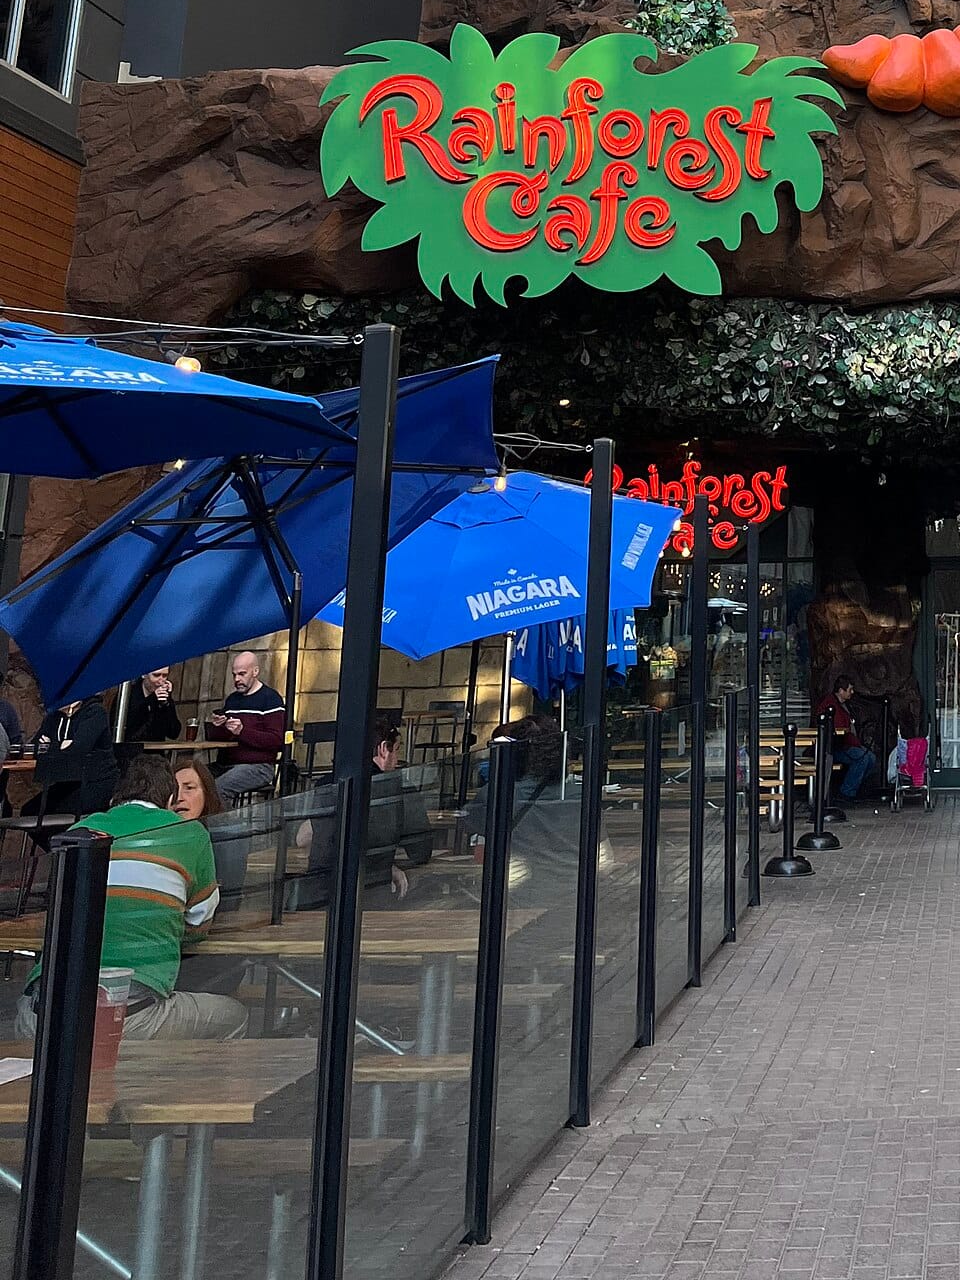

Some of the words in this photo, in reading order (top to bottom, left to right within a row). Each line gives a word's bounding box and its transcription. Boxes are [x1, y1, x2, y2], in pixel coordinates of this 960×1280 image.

[358, 73, 776, 203] Rainforest
[462, 161, 677, 266] Cafe
[466, 576, 580, 620] NIAGARA
[495, 606, 534, 618] PREMIUM
[535, 600, 560, 610] LAGER
